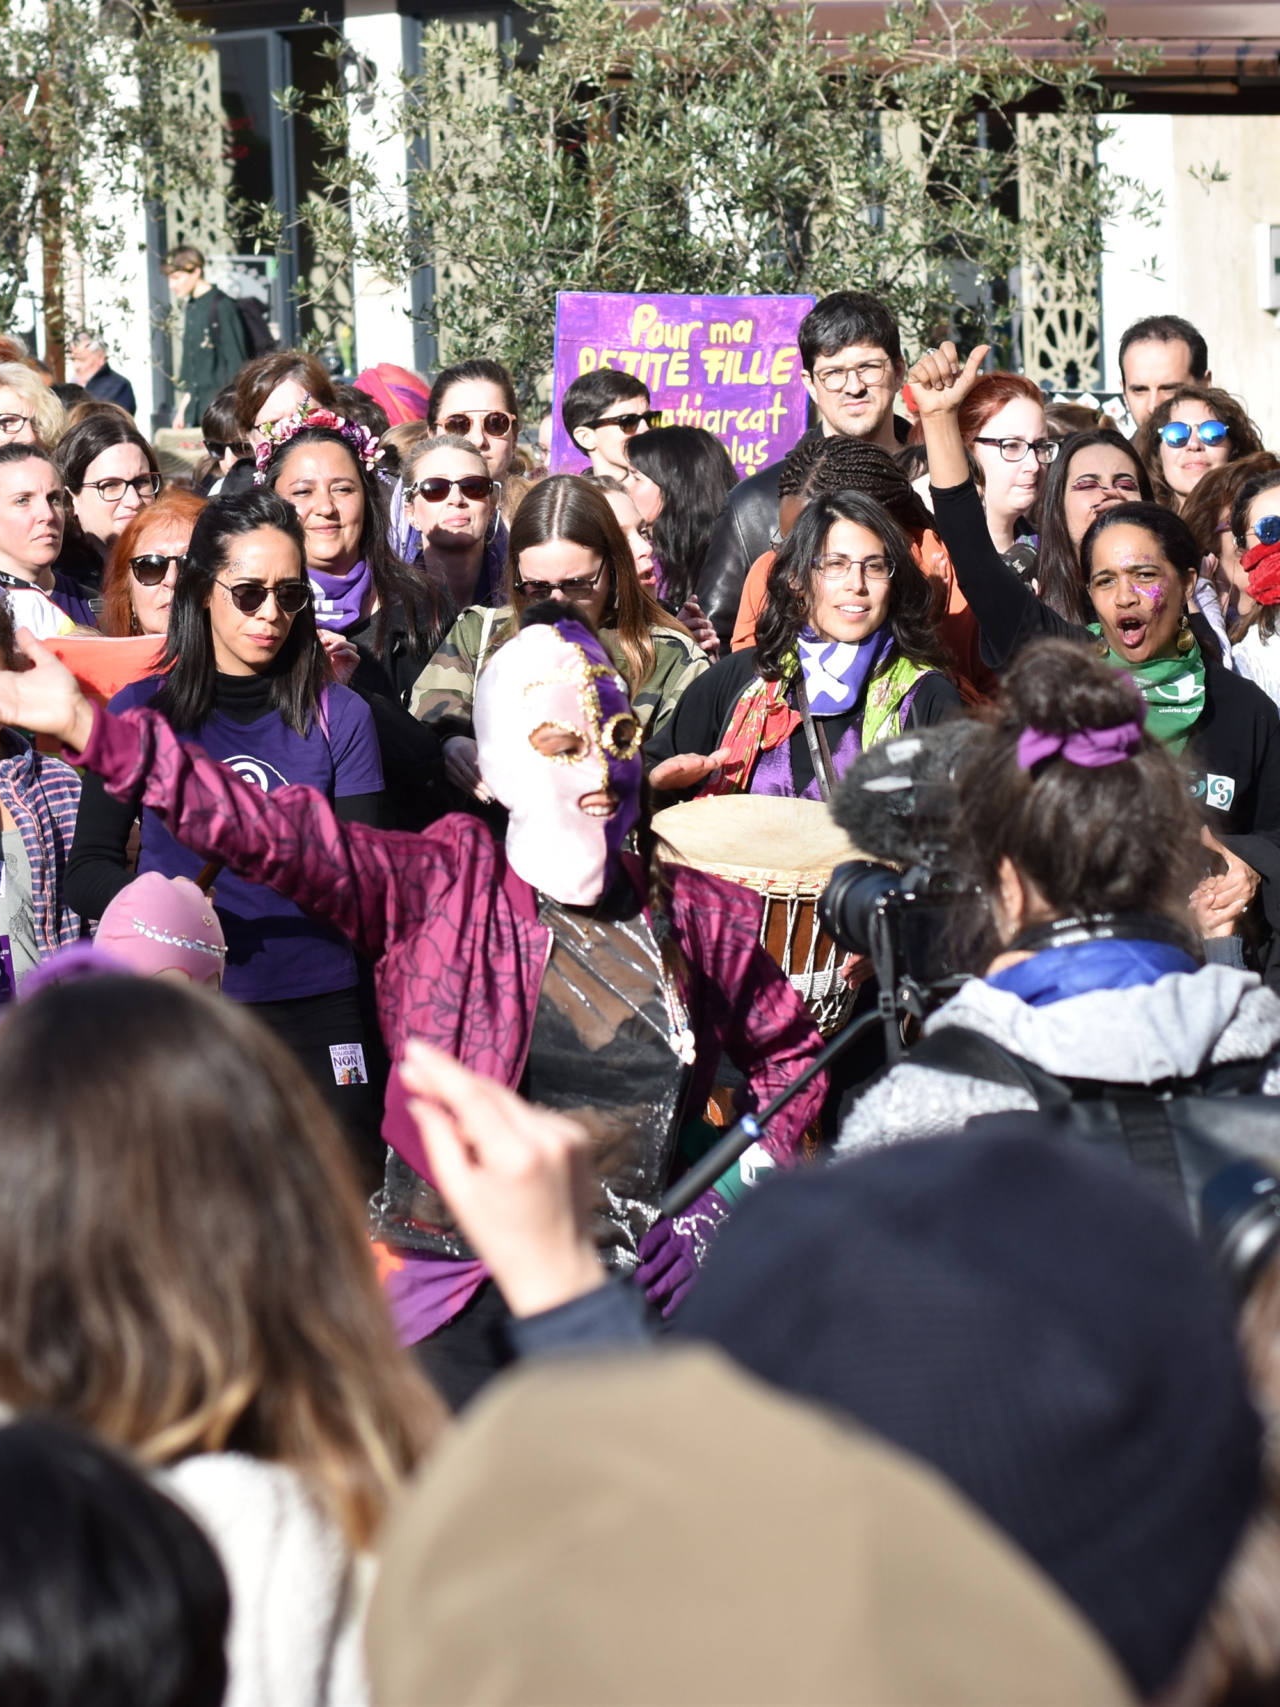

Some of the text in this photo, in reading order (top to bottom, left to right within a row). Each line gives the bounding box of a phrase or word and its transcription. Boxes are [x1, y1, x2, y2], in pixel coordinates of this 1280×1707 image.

[631, 303, 753, 350] Pour ma
[578, 346, 797, 392] PETITE FILLE
[651, 391, 788, 434] atriarcat
[333, 1055, 358, 1067] NON
